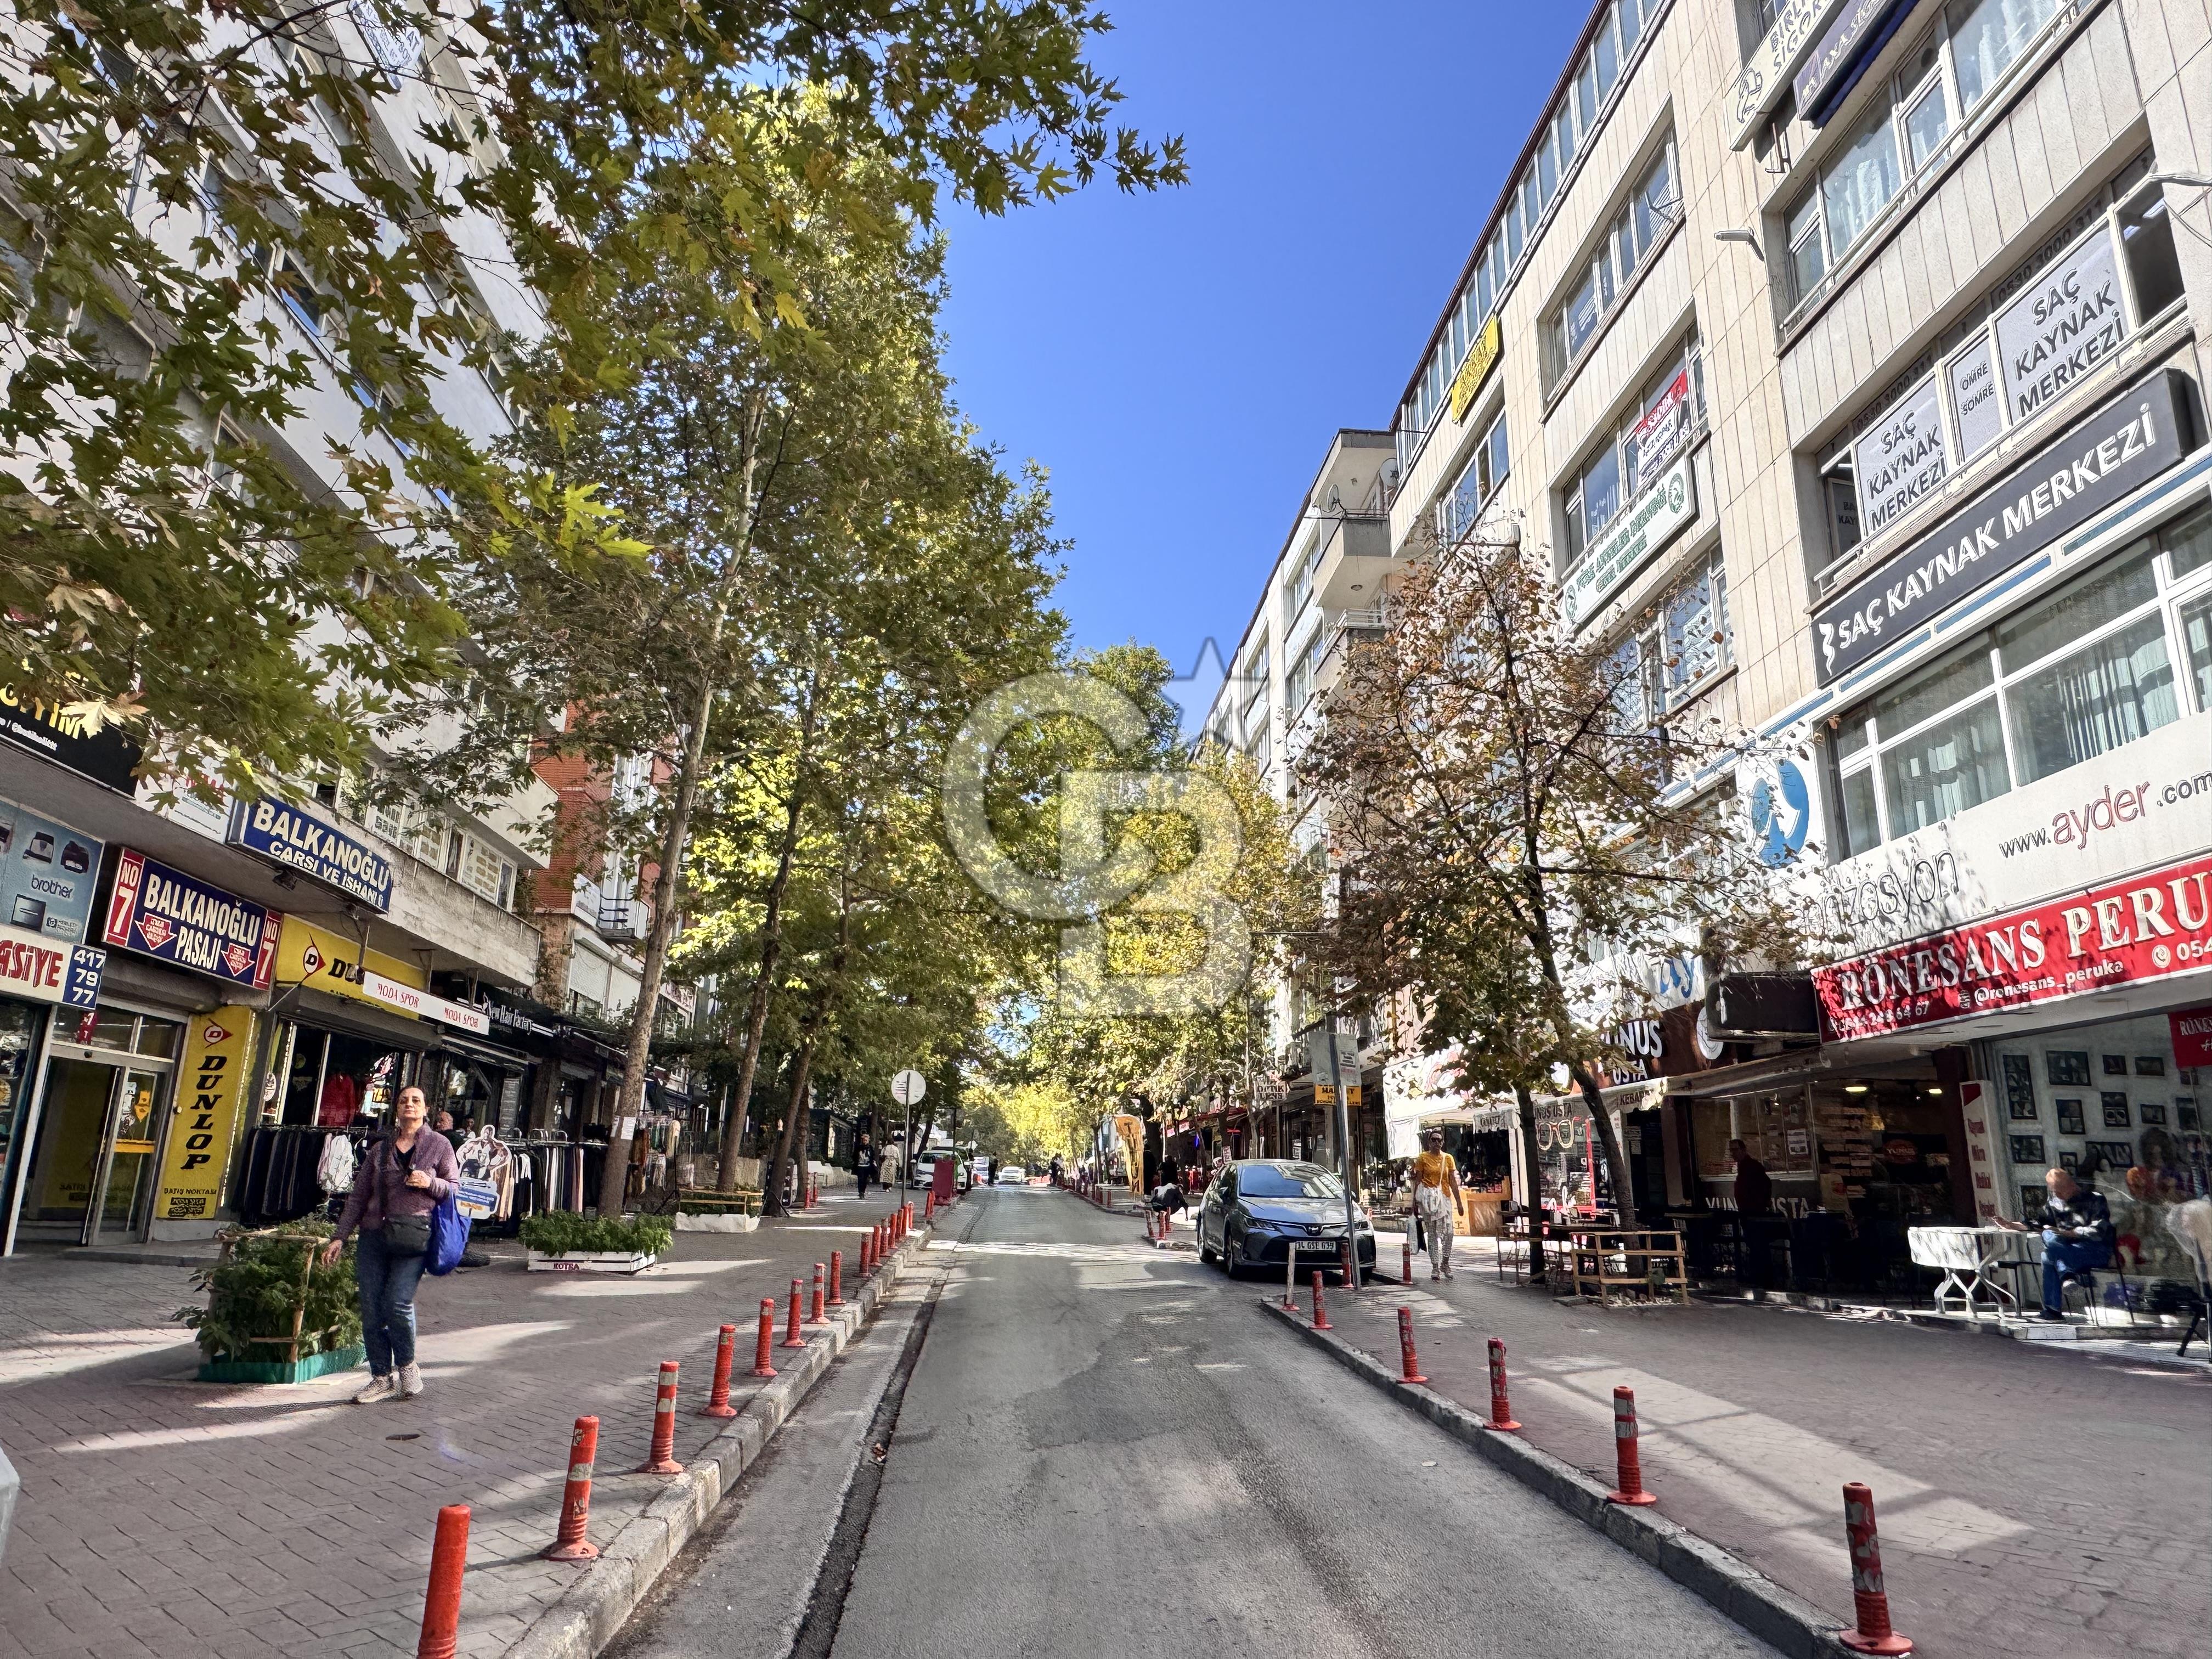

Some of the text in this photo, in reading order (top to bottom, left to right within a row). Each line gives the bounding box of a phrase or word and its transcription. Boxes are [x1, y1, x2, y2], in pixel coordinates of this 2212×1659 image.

[2032, 268, 2080, 326] SAÇ
[2014, 279, 2115, 381] KAYNAK
[2017, 309, 2124, 417] MERKEZİ
[1881, 410, 1916, 454] SAÇ
[1867, 424, 1940, 500] KAYNAK
[1870, 450, 1946, 531] MERKEZİ
[1838, 402, 2157, 648] SAÇ KAYNAK MERKEZİ
[253, 801, 390, 891] BALKANOĞLU
[31, 874, 73, 899] brother
[121, 862, 139, 886] NO
[323, 862, 340, 883] VE
[113, 887, 134, 933] 7
[144, 873, 261, 946] BALKANOĞLU
[265, 920, 277, 940] NO
[74, 949, 106, 969] 417
[174, 926, 222, 970] PASAJI
[260, 941, 274, 980] 7
[1839, 871, 2212, 1011] RÖNESANS PERU
[72, 987, 95, 1005] 77
[76, 968, 99, 987] 79
[1915, 1000, 1931, 1015] 67
[180, 1055, 228, 1170] DUNLOP
